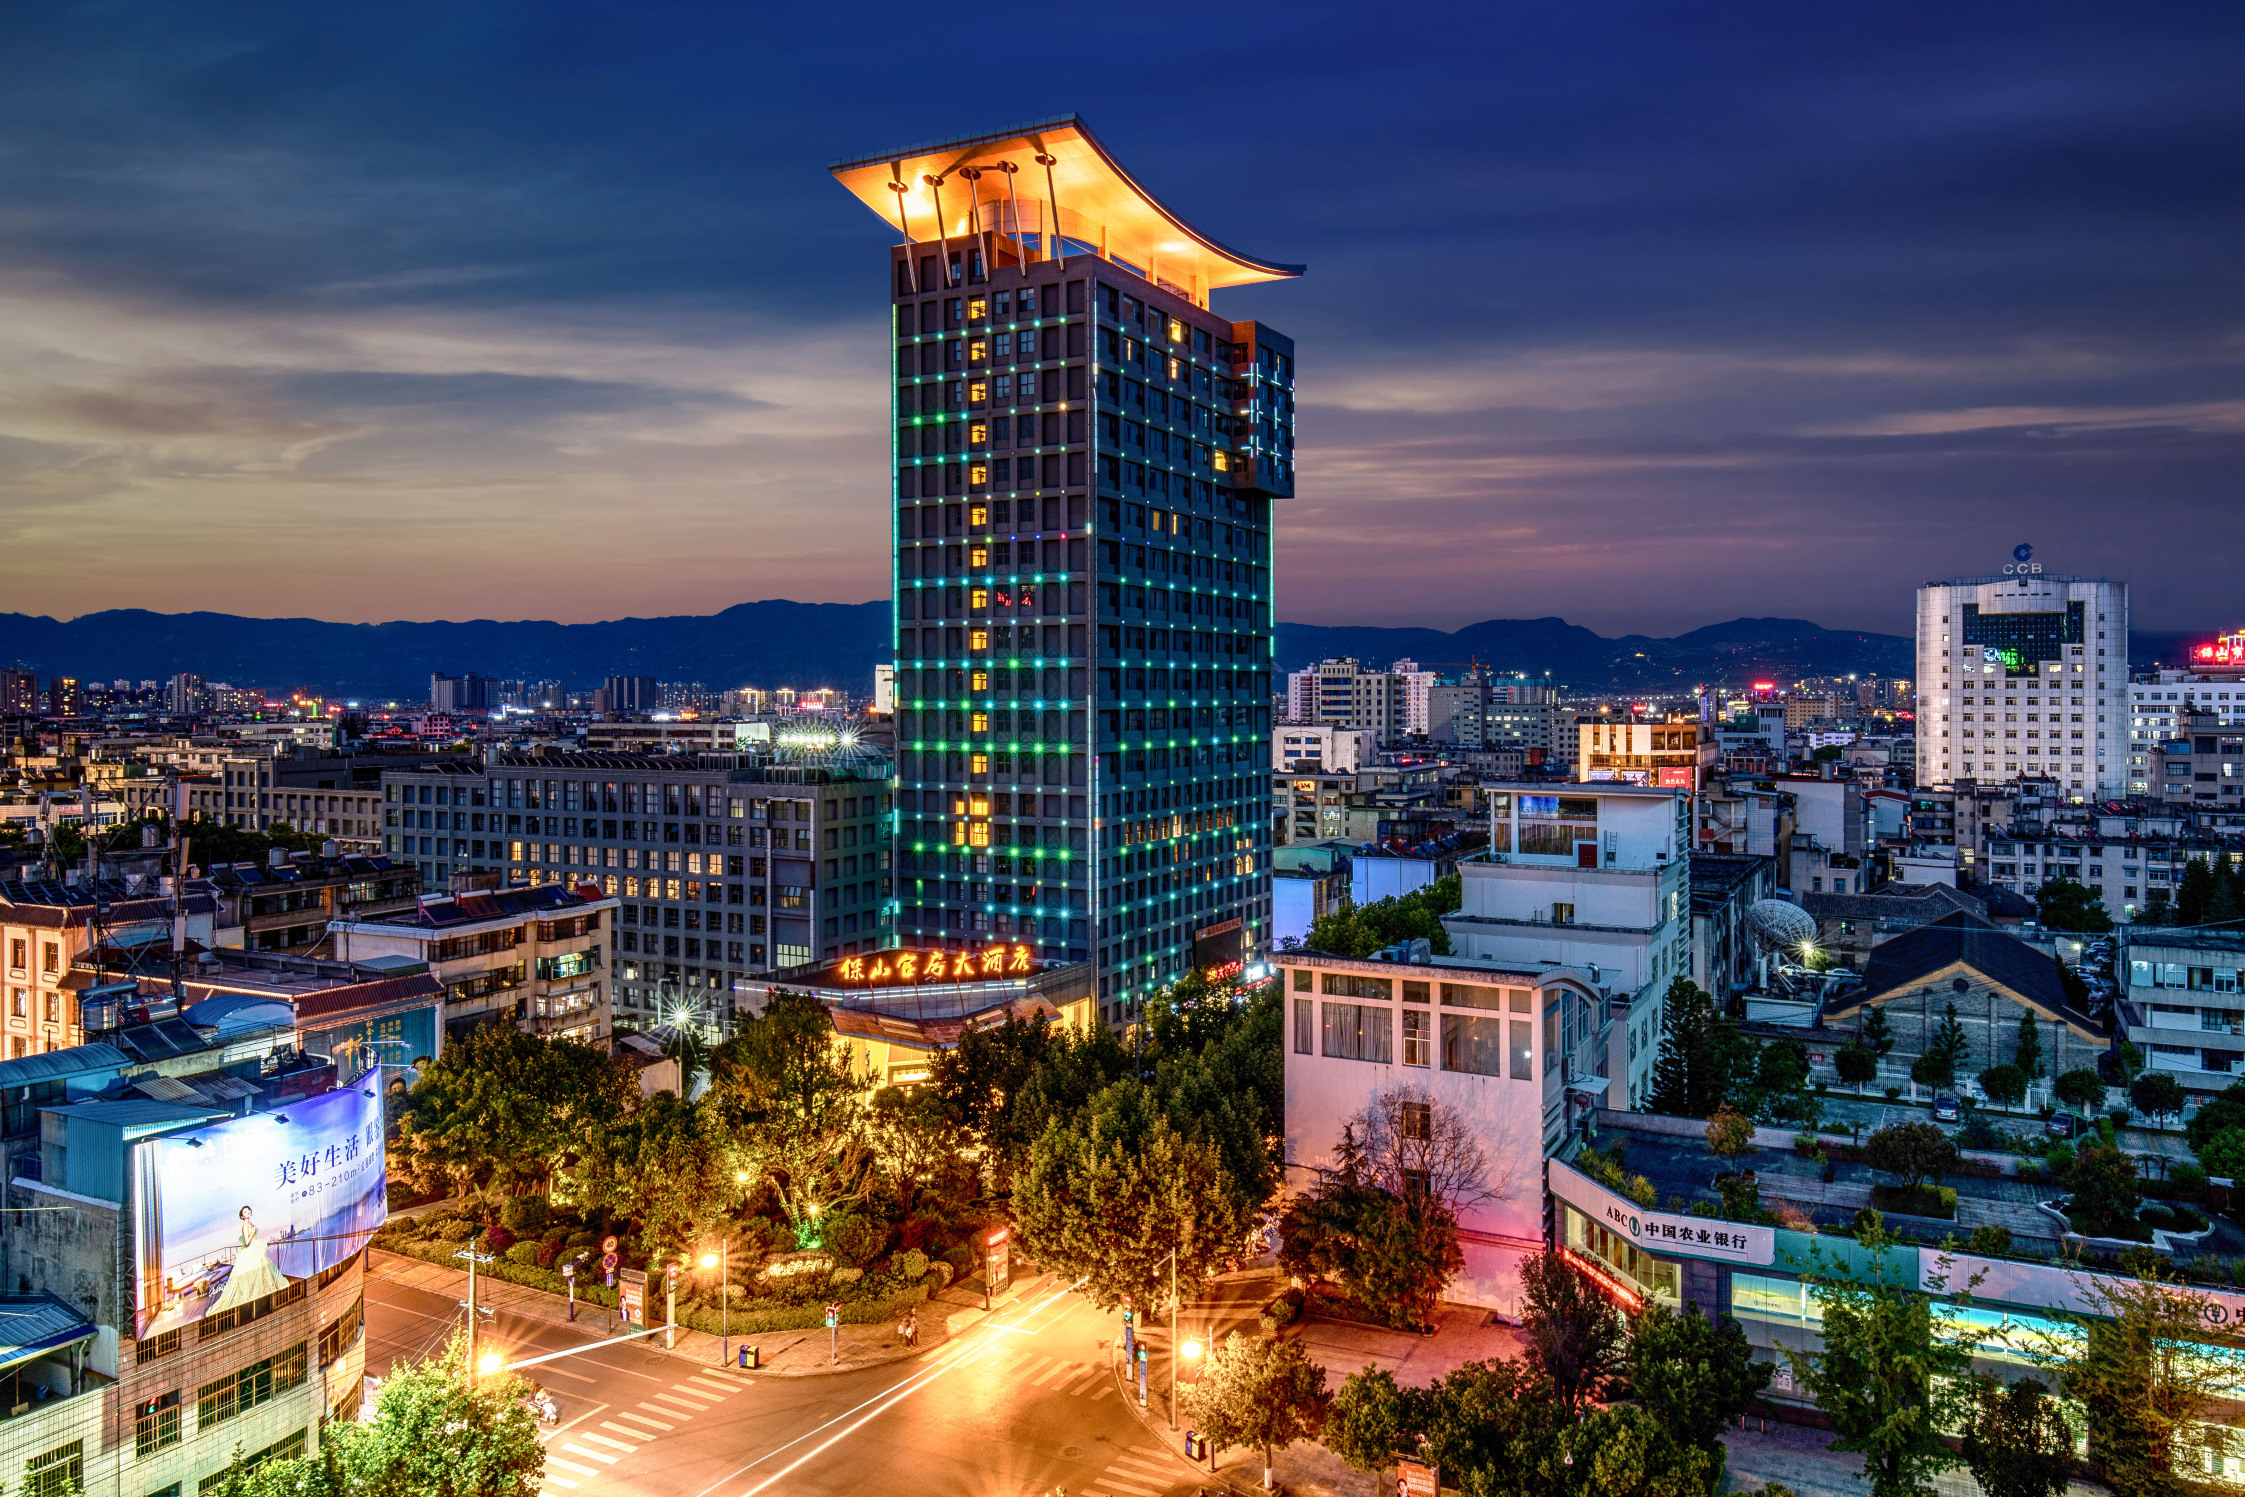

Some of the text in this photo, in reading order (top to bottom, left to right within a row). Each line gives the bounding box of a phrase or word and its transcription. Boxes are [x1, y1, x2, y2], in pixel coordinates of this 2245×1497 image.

[2002, 563, 2043, 575] CCB
[840, 946, 1031, 981] 保山官房大酒店
[274, 1134, 360, 1190] 美好生活
[1606, 1205, 1628, 1227] ABC
[1645, 1222, 1748, 1249] 中国农业银行
